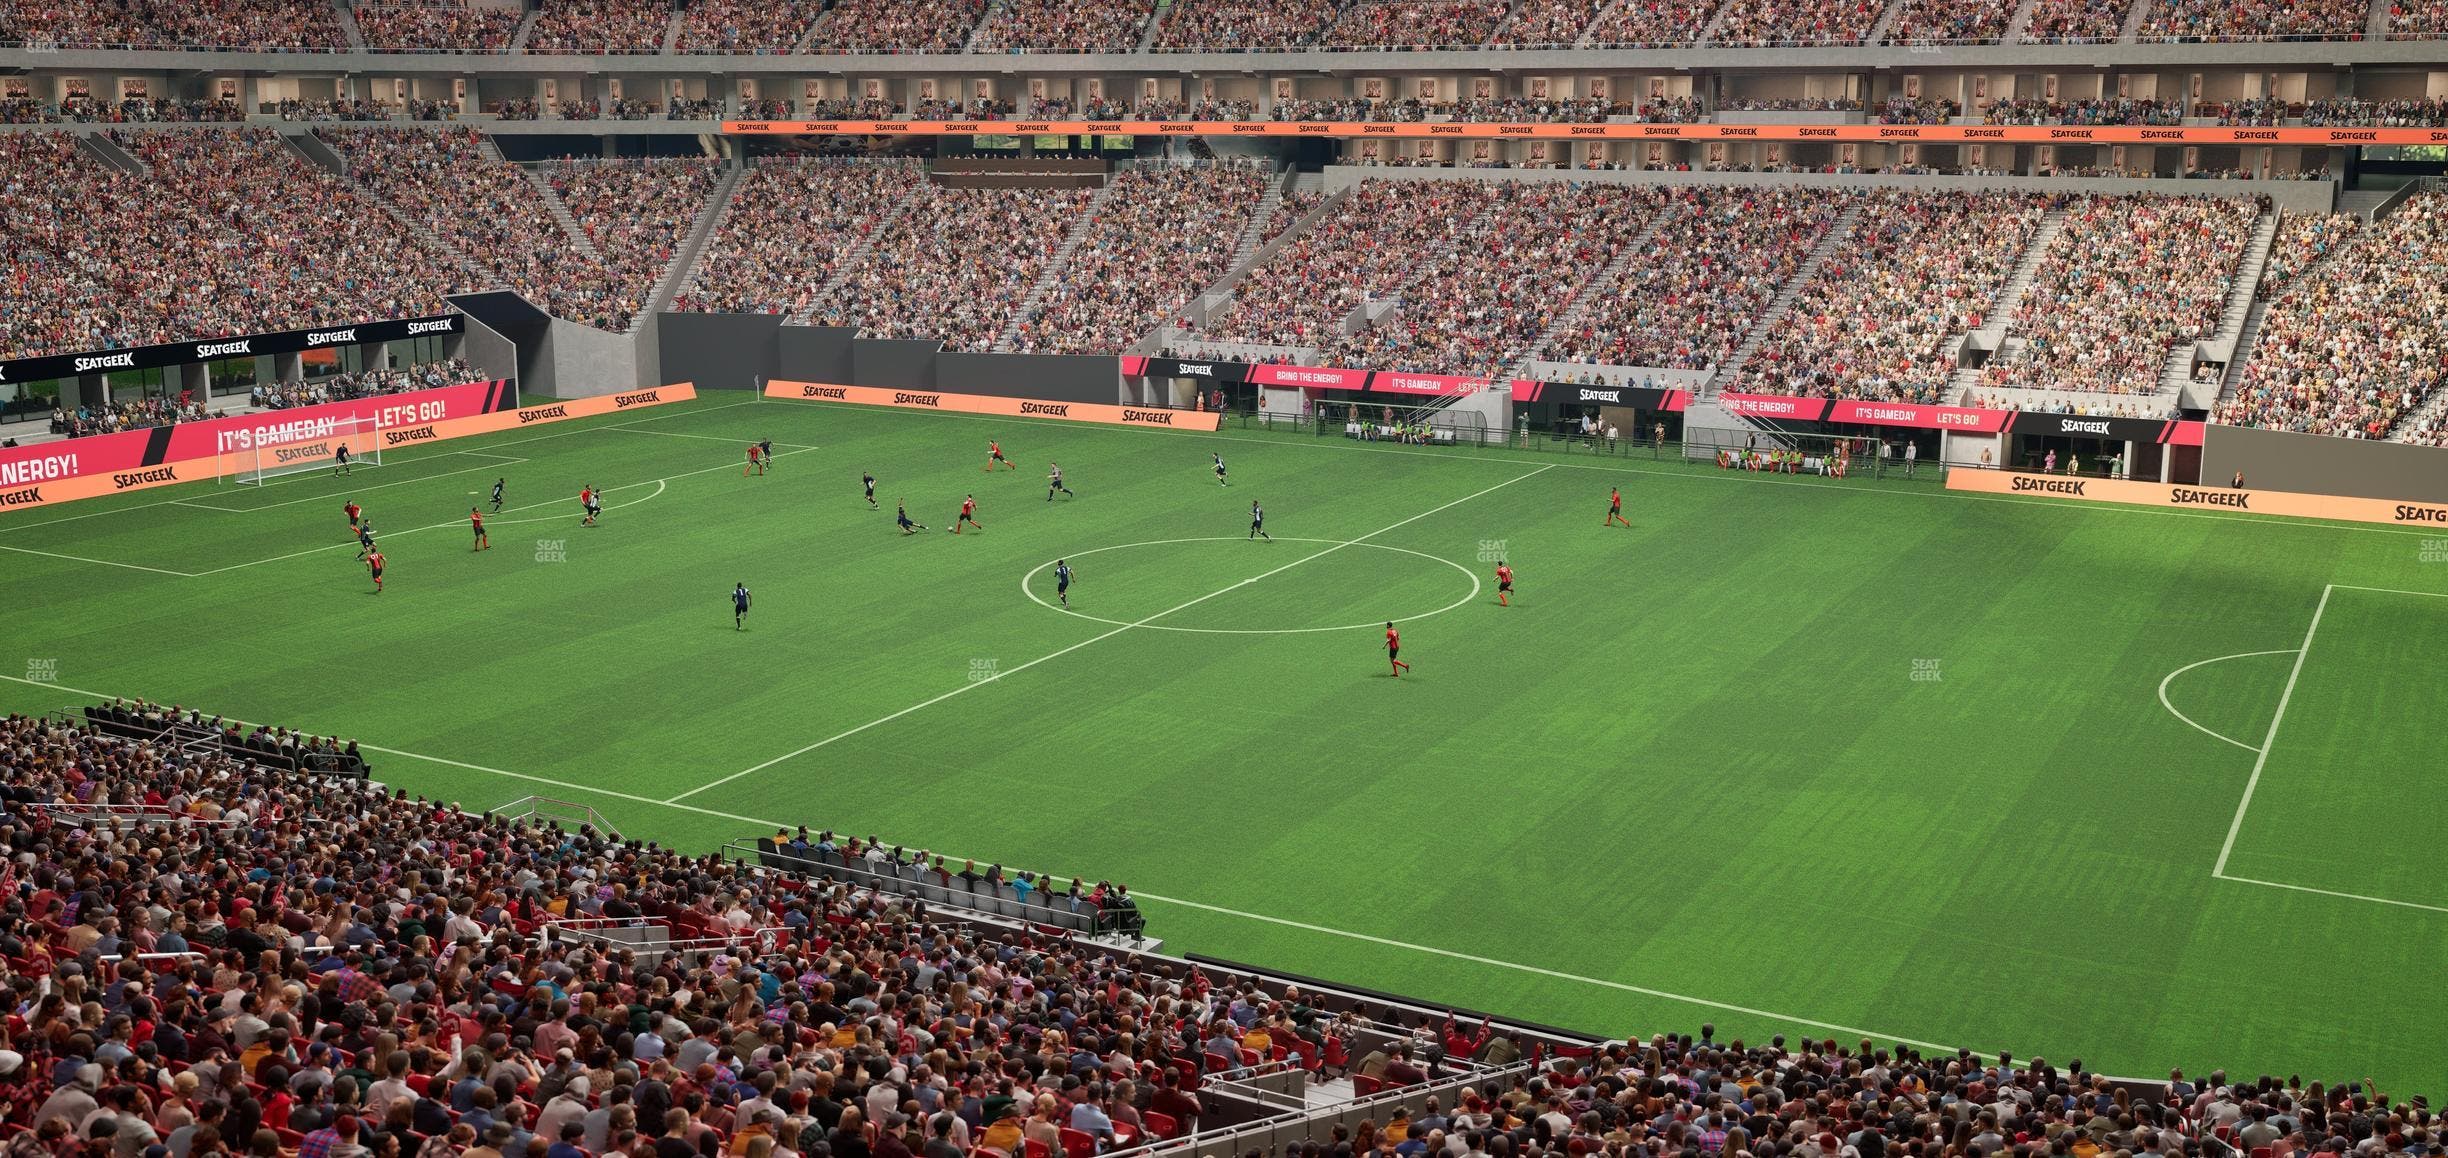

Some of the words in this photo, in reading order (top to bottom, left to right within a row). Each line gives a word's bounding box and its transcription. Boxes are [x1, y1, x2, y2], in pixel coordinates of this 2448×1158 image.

[737, 124, 770, 132] SEATGEEK
[806, 124, 839, 132] SEATGEEK
[874, 124, 907, 132] SEATGEEK
[944, 124, 978, 132] SEATGEEK
[1016, 124, 1050, 132] SEATGEEK
[1088, 124, 1122, 132] SEATGEEK
[1160, 124, 1195, 133] SEATGEEK
[1233, 124, 1266, 133] SEATGEEK
[1299, 125, 1330, 133] SEATGEEK
[1364, 125, 1396, 133] SEATGEEK
[1431, 126, 1464, 134] SEATGEEK
[1501, 126, 1534, 134] SEATGEEK
[1572, 126, 1606, 135] SEATGEEK
[1645, 127, 1680, 136] SEATGEEK
[1721, 127, 1757, 136] SEATGEEK
[1799, 128, 1837, 137] SEATGEEK
[1880, 128, 1919, 138] SEATGEEK
[1964, 128, 2004, 138] SEATGEEK
[2050, 129, 2092, 139] SEATGEEK
[2140, 130, 2183, 140] SEATGEEK
[2233, 130, 2279, 140] SEATGEEK
[2330, 131, 2376, 141] SEATGEEK
[75, 352, 134, 372] SEATGEEK
[197, 339, 251, 359] SEATGEEK
[308, 329, 357, 346] SEATGEEK
[408, 318, 453, 335] SEATGEEK
[1179, 363, 1213, 377] SEATGEEK
[1276, 370, 1298, 381] BRING
[1299, 372, 1312, 382] THE
[1313, 373, 1343, 384] ENERGY!
[1392, 378, 1406, 389] IT'S
[1407, 378, 1441, 391] GAMEDAY
[1580, 388, 1620, 403] SEATGEEK
[803, 385, 847, 400] SEATGEEK
[894, 392, 939, 407] SEATGEEK
[1021, 401, 1069, 417] SEATGEEK
[1123, 409, 1173, 425] SEATGEEK
[1742, 400, 1757, 411] THE
[1759, 401, 1795, 414] ENERGY!
[376, 403, 416, 428] LET'S
[420, 400, 446, 421] GO!
[1856, 407, 1872, 419] IT'S
[1874, 408, 1916, 421] GAMEDAY
[1937, 413, 1961, 424] LET'S
[1963, 414, 1979, 426] GO!
[218, 429, 250, 452] IT'S
[256, 416, 336, 446] GAMEDAY
[2061, 419, 2110, 435] SEATGEEK
[114, 466, 178, 489] SEATGEEK
[275, 442, 331, 463] SEATGEEK
[386, 425, 437, 445] SEATGEEK
[519, 405, 568, 424] SEATGEEK
[616, 390, 661, 408] SEATGEEK
[0, 453, 78, 486] NERGY!
[2012, 476, 2086, 495] SEATGEEK
[2172, 489, 2250, 507] SEATGEEK
